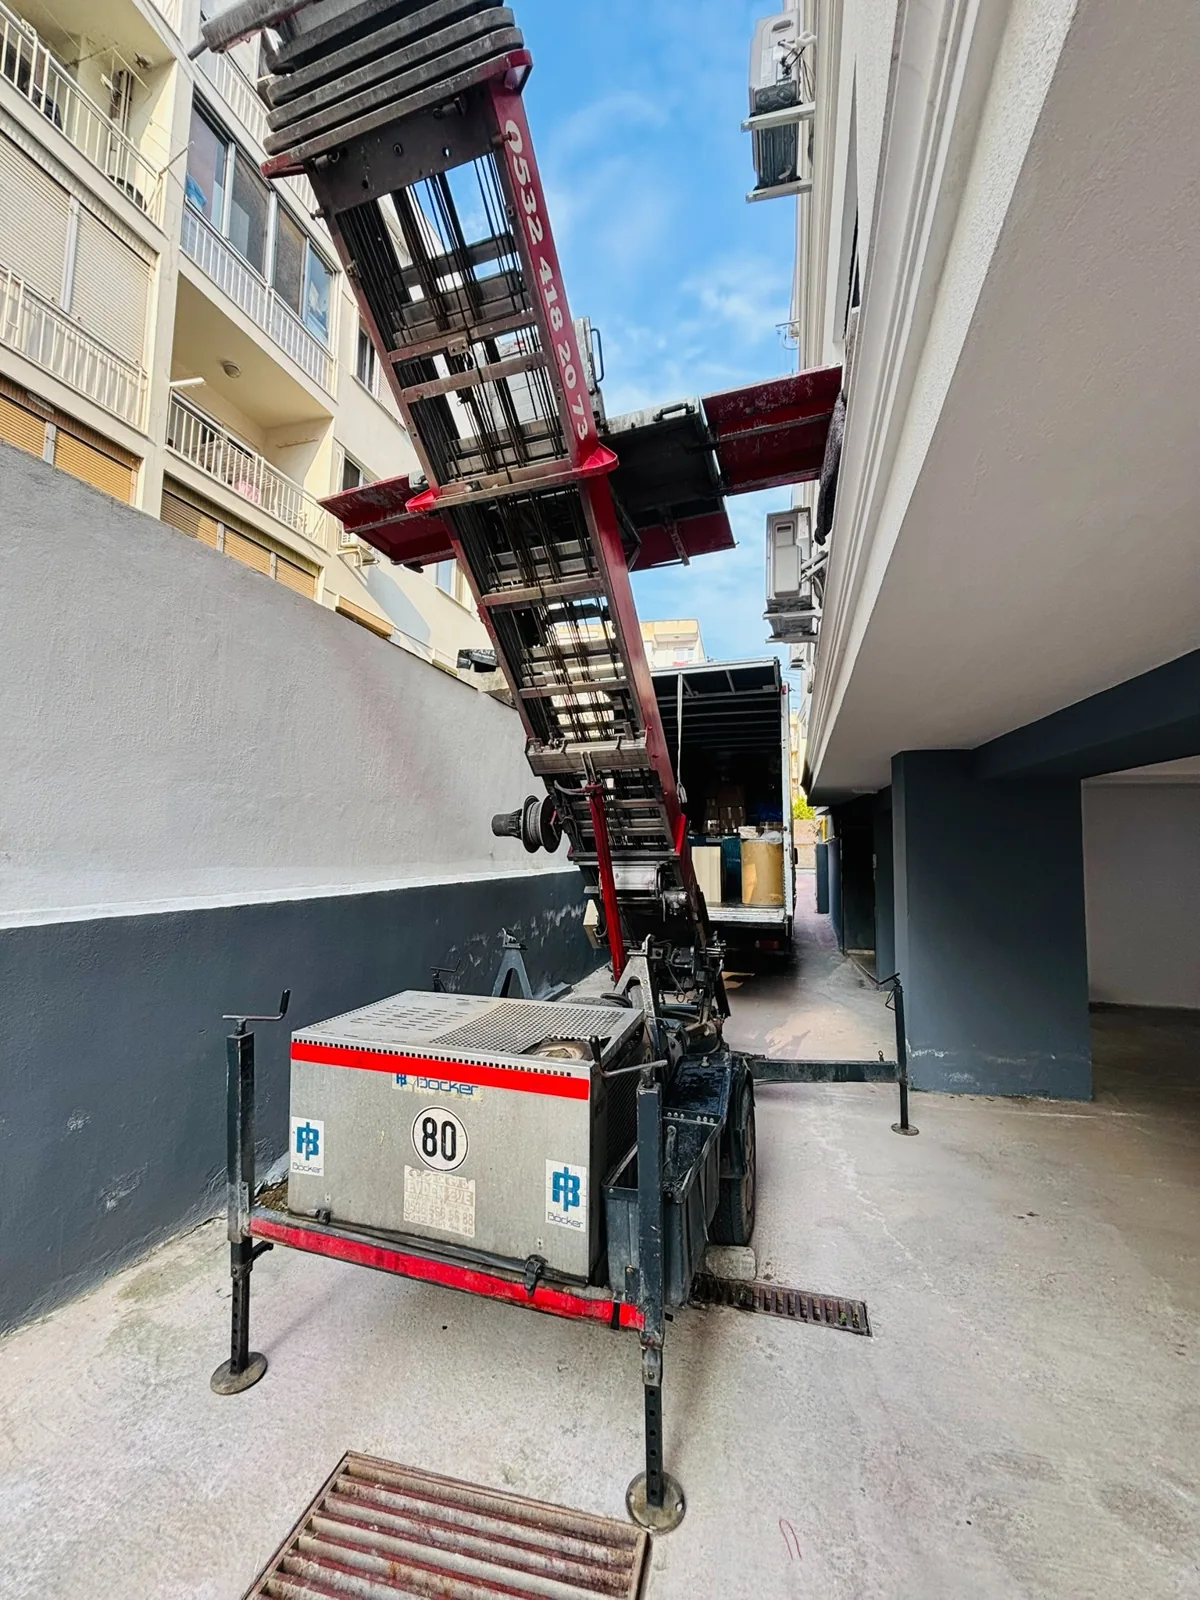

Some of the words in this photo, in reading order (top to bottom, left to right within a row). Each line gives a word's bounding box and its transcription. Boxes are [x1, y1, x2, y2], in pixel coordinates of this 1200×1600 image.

[505, 119, 543, 246] 0532
[538, 256, 565, 332] 418
[556, 343, 578, 390] 20
[568, 397, 589, 441] 73
[422, 1117, 456, 1161] 80
[547, 1211, 584, 1228] Böcker
